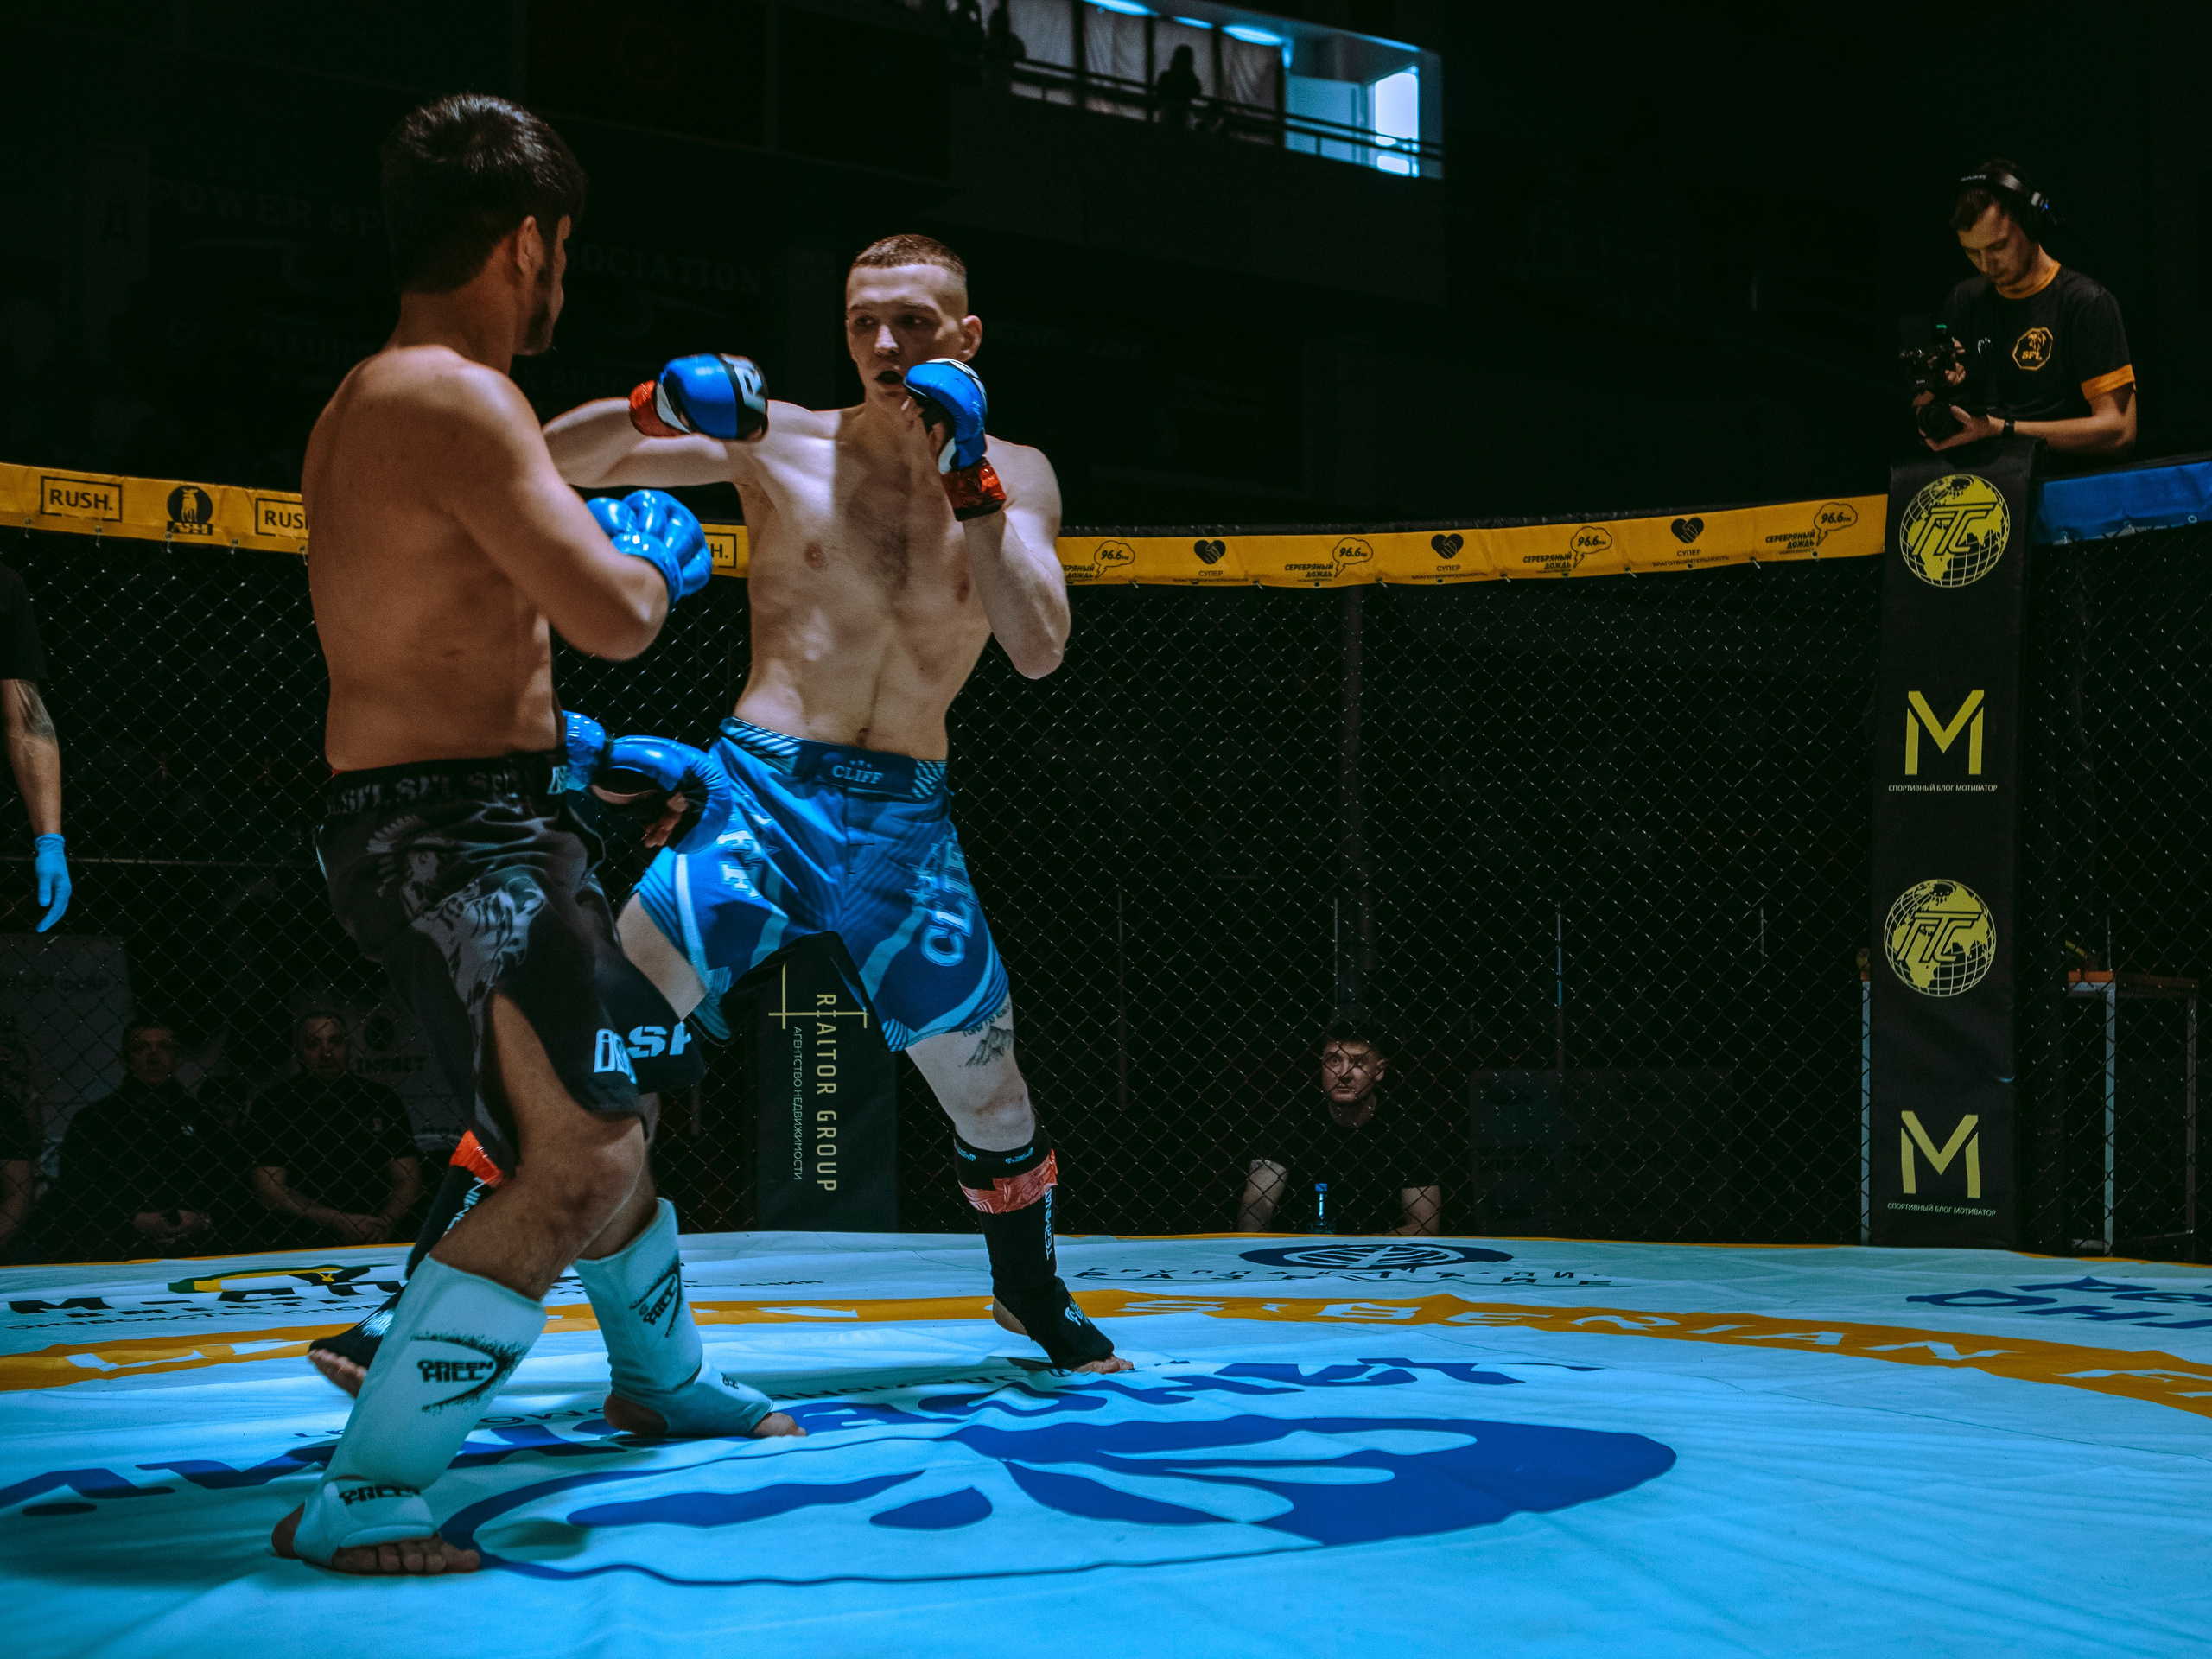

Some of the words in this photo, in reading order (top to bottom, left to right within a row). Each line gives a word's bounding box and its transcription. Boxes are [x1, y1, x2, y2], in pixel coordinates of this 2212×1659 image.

[49, 489, 113, 511] RUSH.
[264, 510, 308, 530] RUS
[1765, 529, 1815, 543] СЕРЕБРЯНЫЙ
[1787, 539, 1814, 550] ДОЖДЬ
[1523, 551, 1572, 563] СЕРЕБРЯНЫЙ
[1676, 549, 1701, 557] СУПЕР
[1285, 562, 1333, 571] СЕРЕБРЯНЫЙ
[832, 764, 884, 785] CLIFF
[1888, 784, 1935, 792] СПОРТИВНЫЙ
[1936, 784, 1955, 792] БЛОГ
[1955, 784, 1998, 792] МОТИВАТОР
[793, 1026, 802, 1087] АГЕНТСТВО
[792, 1090, 803, 1180] НЕДВИЖИМОСТИ
[817, 1110, 837, 1192] GROUP
[1887, 1202, 1934, 1212] СПОРТИВНЫЙ
[1935, 1205, 1953, 1214] БЛОГ
[1954, 1206, 1997, 1217] МОТИВАТОР
